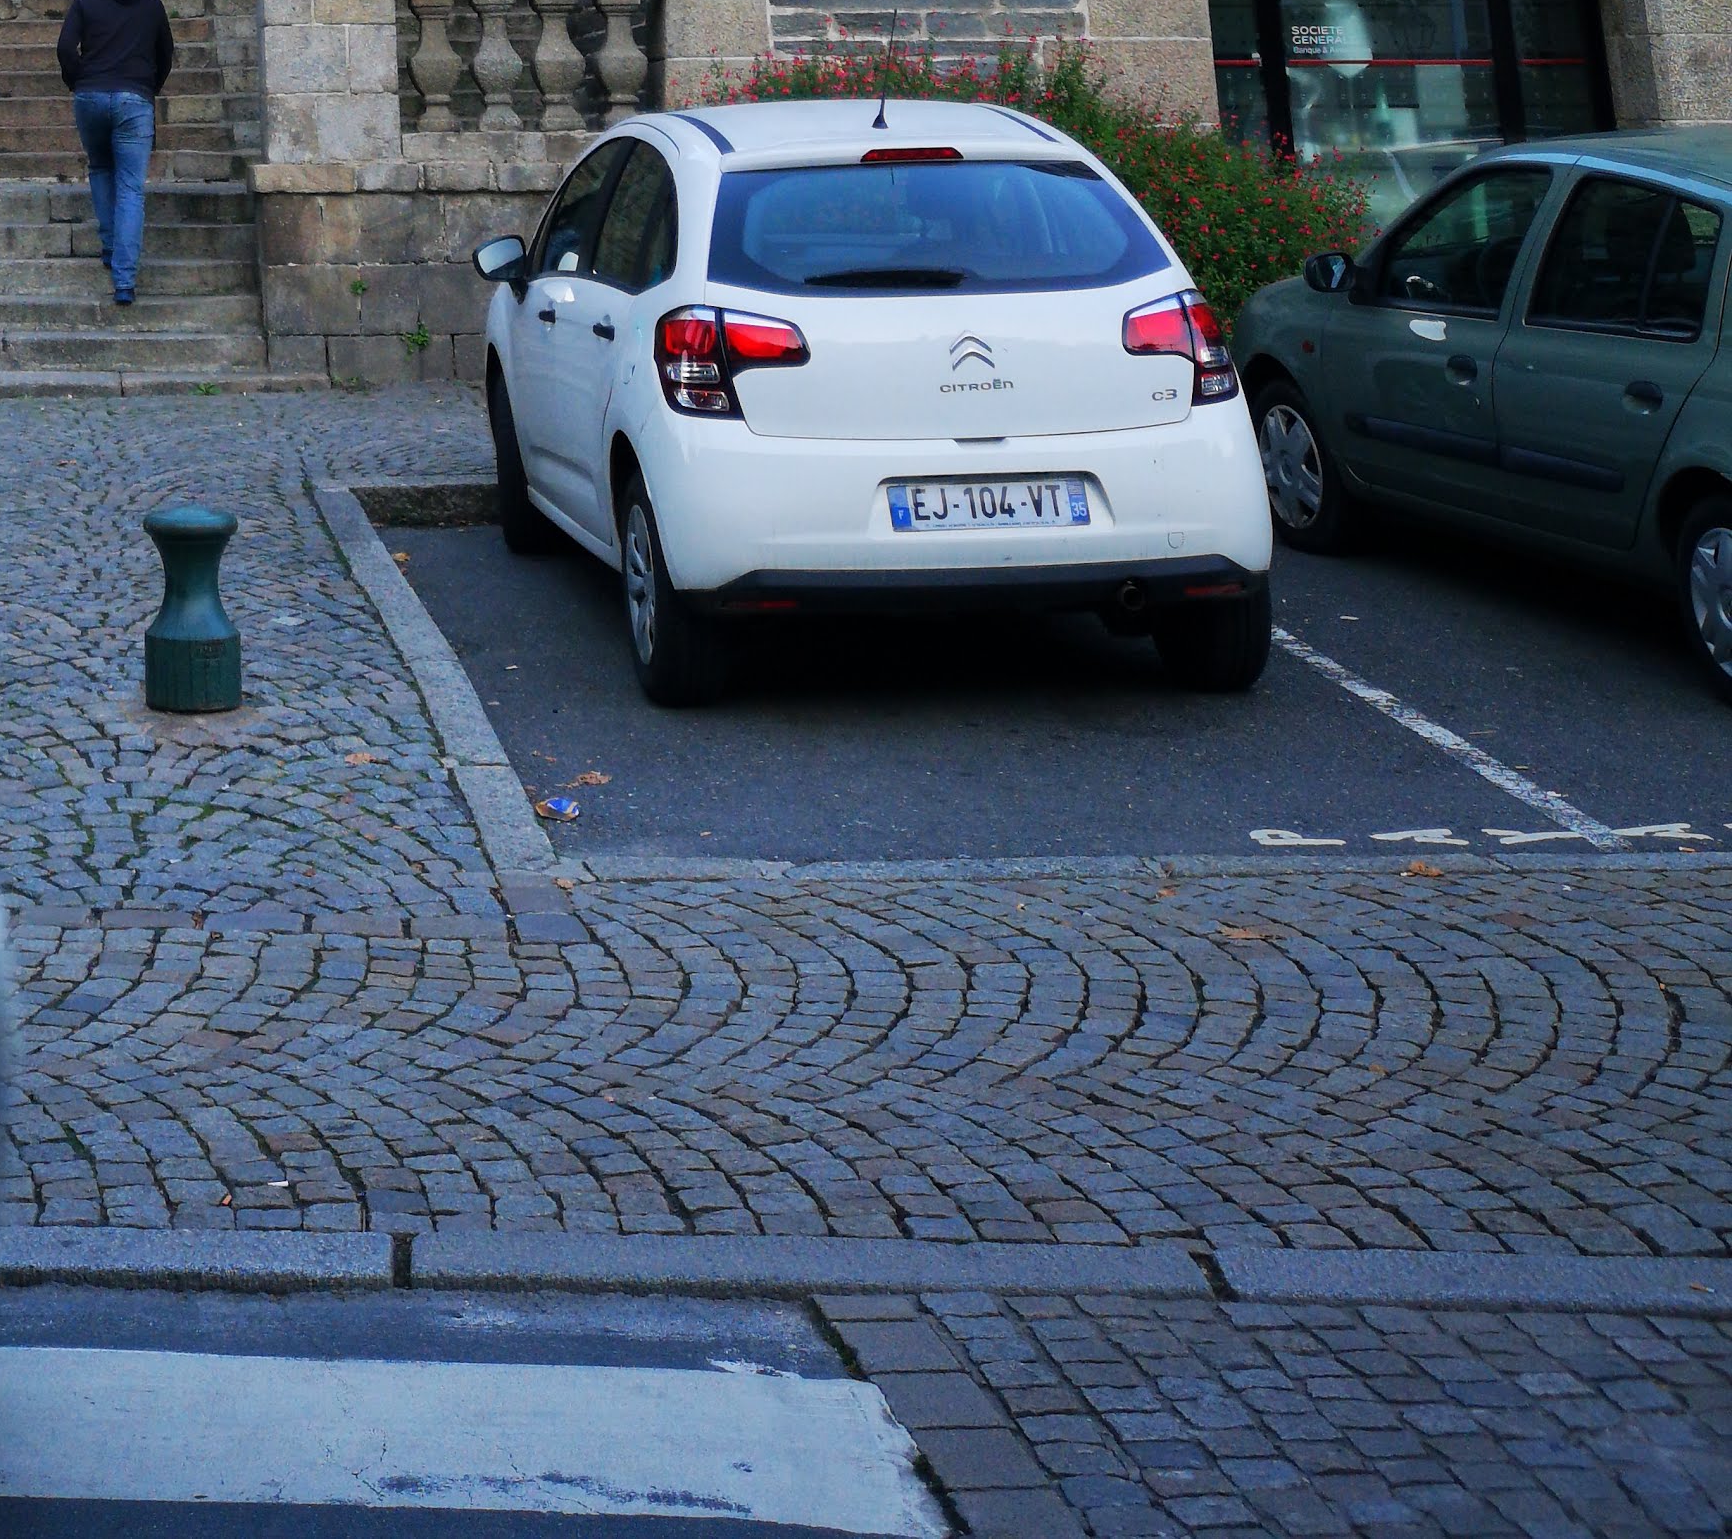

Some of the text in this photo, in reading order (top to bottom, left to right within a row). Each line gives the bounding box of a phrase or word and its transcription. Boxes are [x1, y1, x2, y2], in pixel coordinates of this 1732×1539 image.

[1291, 26, 1344, 35] SOCIETE
[1292, 36, 1349, 44] GENERAL
[1293, 46, 1321, 54] Banque
[1151, 388, 1178, 401] C3
[911, 485, 1060, 520] EJ-104-VT
[1071, 502, 1088, 517] 35
[1249, 822, 1732, 846] PAYA
